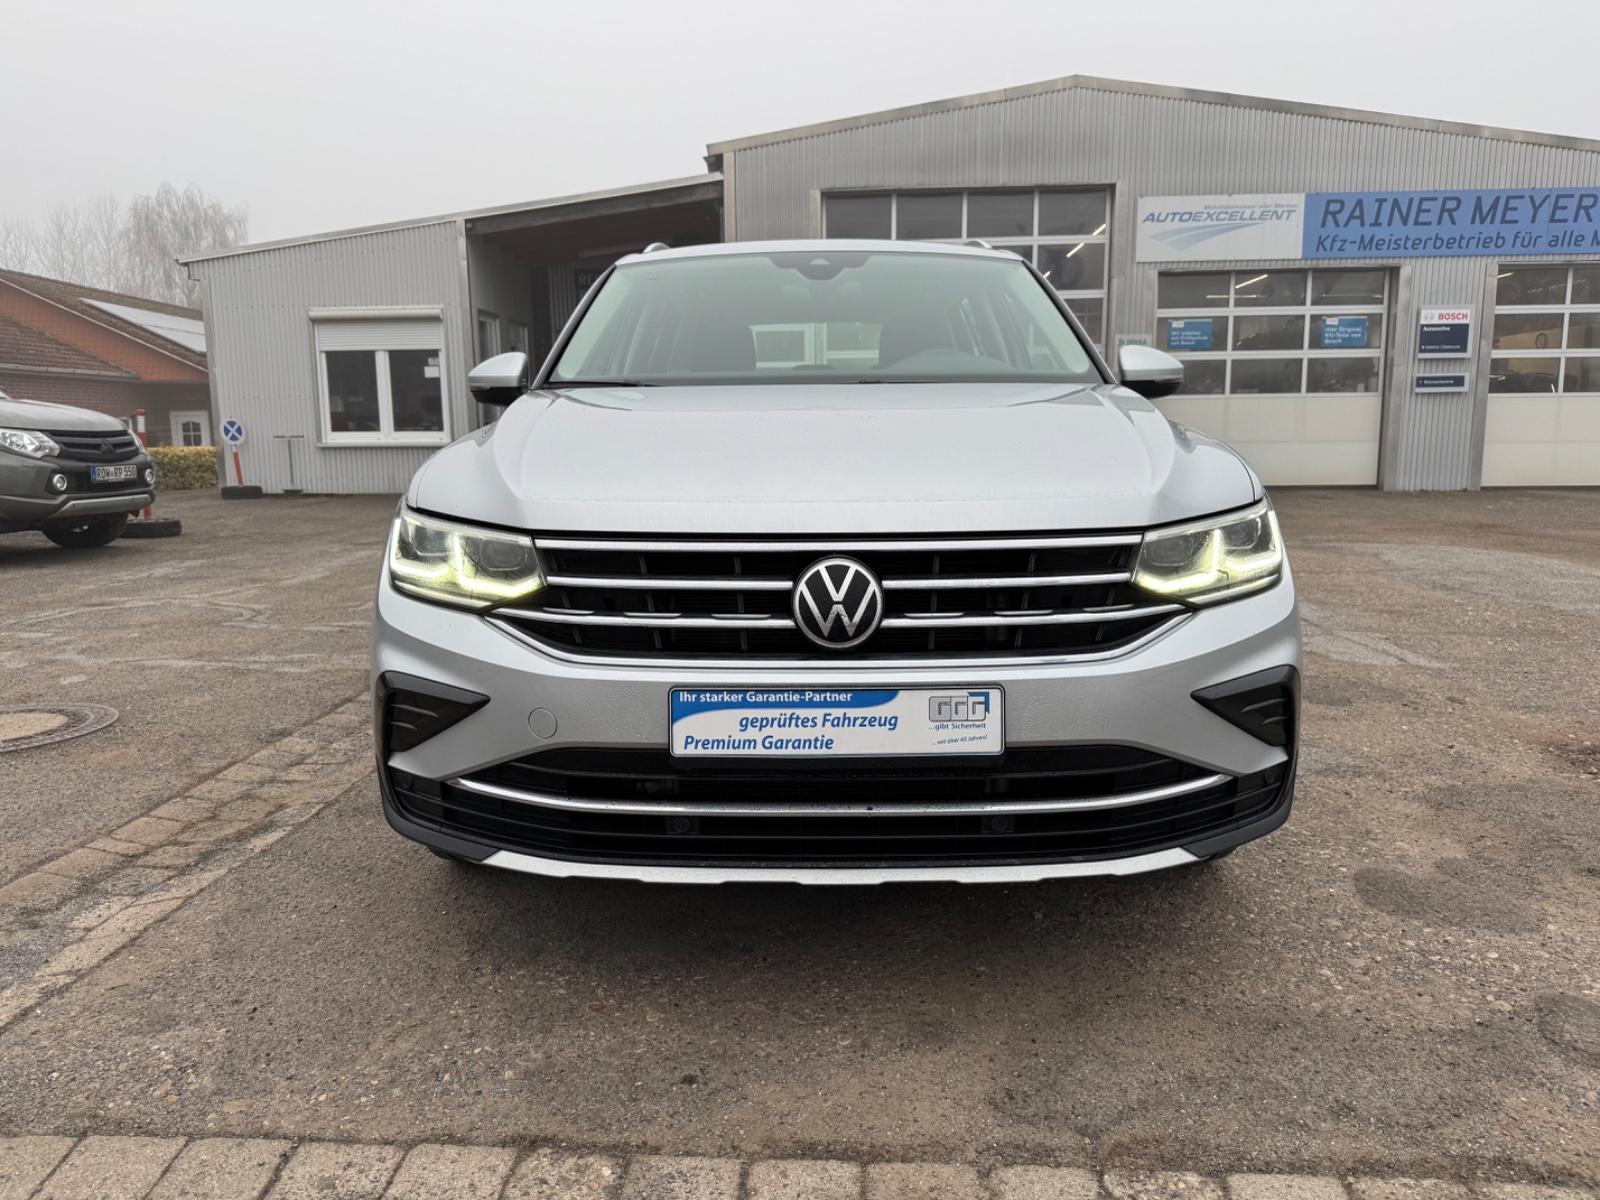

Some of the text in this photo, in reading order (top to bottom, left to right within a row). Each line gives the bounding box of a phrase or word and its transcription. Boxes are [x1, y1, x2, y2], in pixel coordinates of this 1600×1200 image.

[1142, 209, 1297, 223] AUTOEXCELLENT
[1320, 193, 1599, 228] RAINER MEYER
[1315, 231, 1506, 252] Kfz-Meisterbetrieb
[1511, 231, 1543, 249] für
[1548, 230, 1585, 248] alle
[1438, 312, 1468, 321] BOSCH
[680, 691, 853, 702] Ihr starker Garantie-Partner
[739, 712, 898, 732] geprüftes Fahrzeug
[684, 735, 834, 750] Premium Garantie
